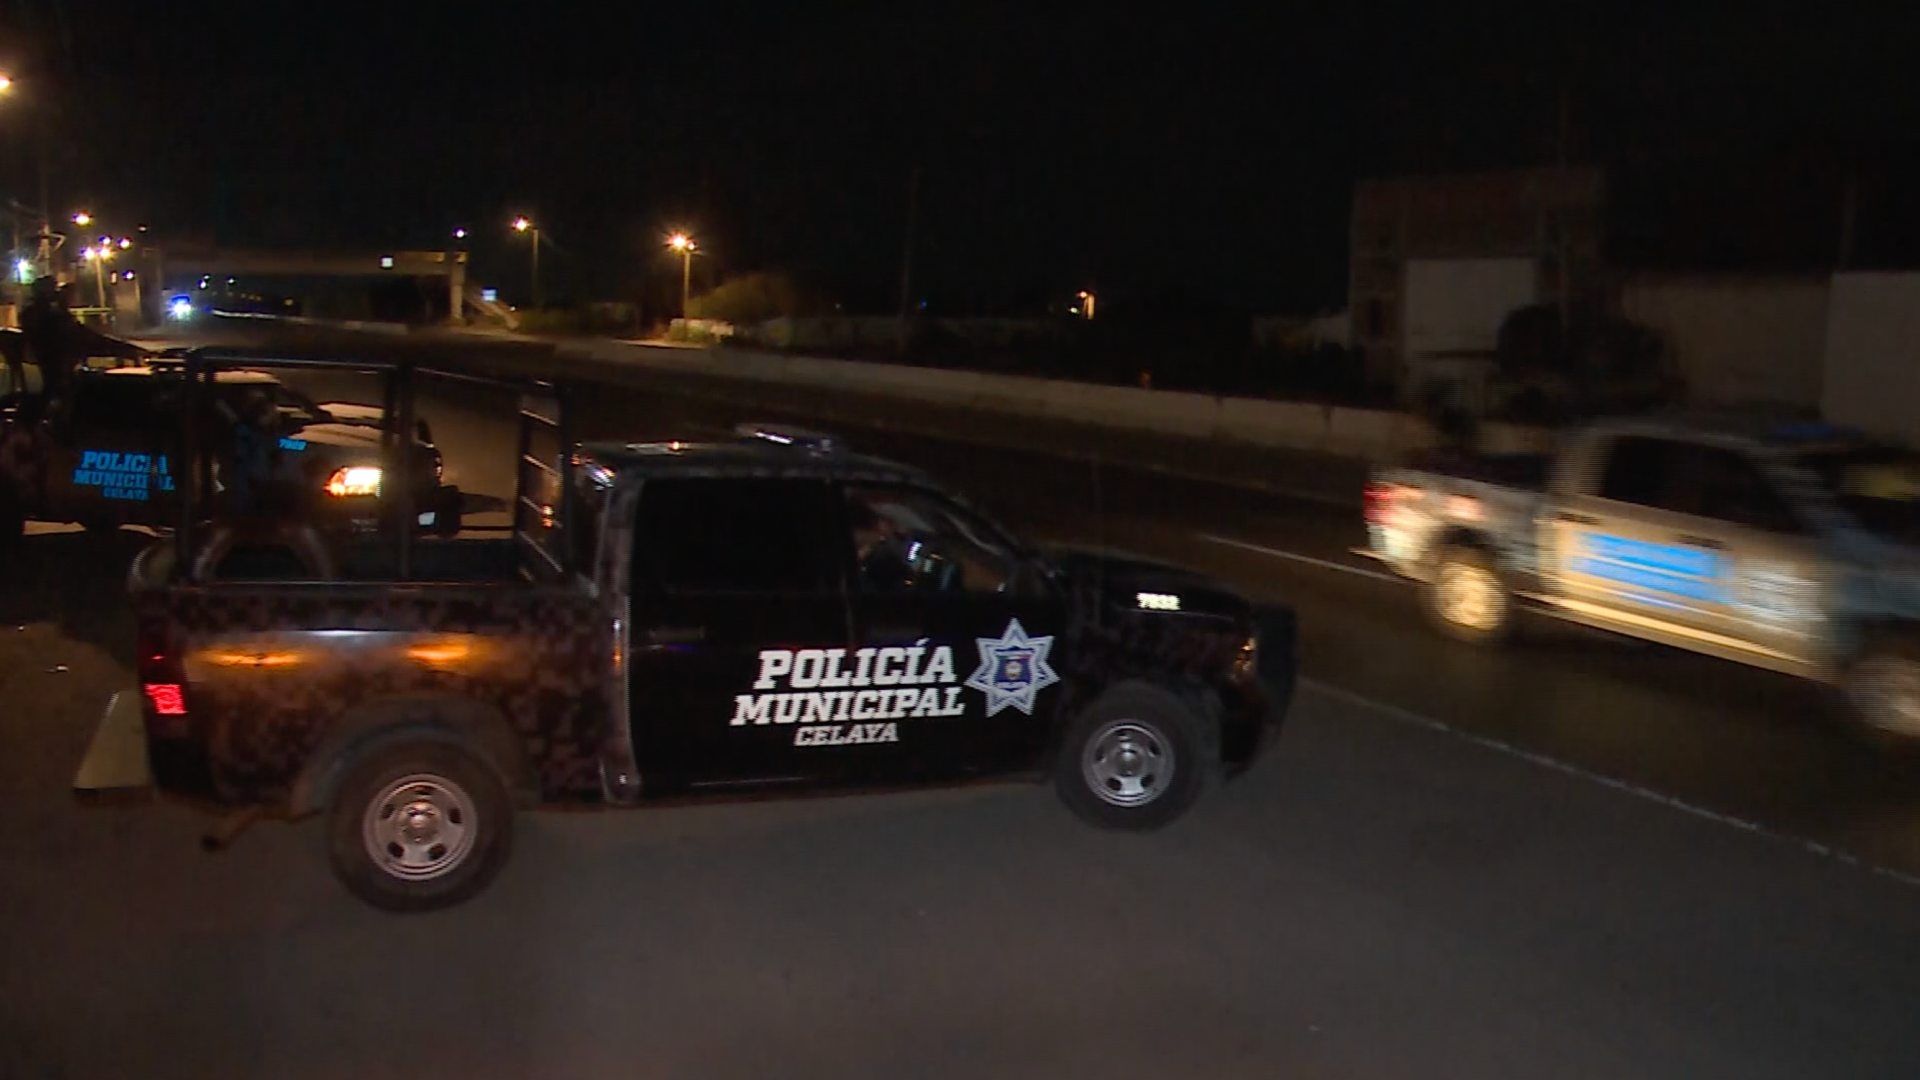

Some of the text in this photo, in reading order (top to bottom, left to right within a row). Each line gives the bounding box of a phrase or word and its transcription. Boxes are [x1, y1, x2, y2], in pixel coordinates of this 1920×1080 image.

[73, 469, 176, 491] MUNICIL
[753, 638, 957, 689] POLICÍA
[730, 687, 965, 726] MUNICIPAL
[794, 723, 899, 746] CELAYA
